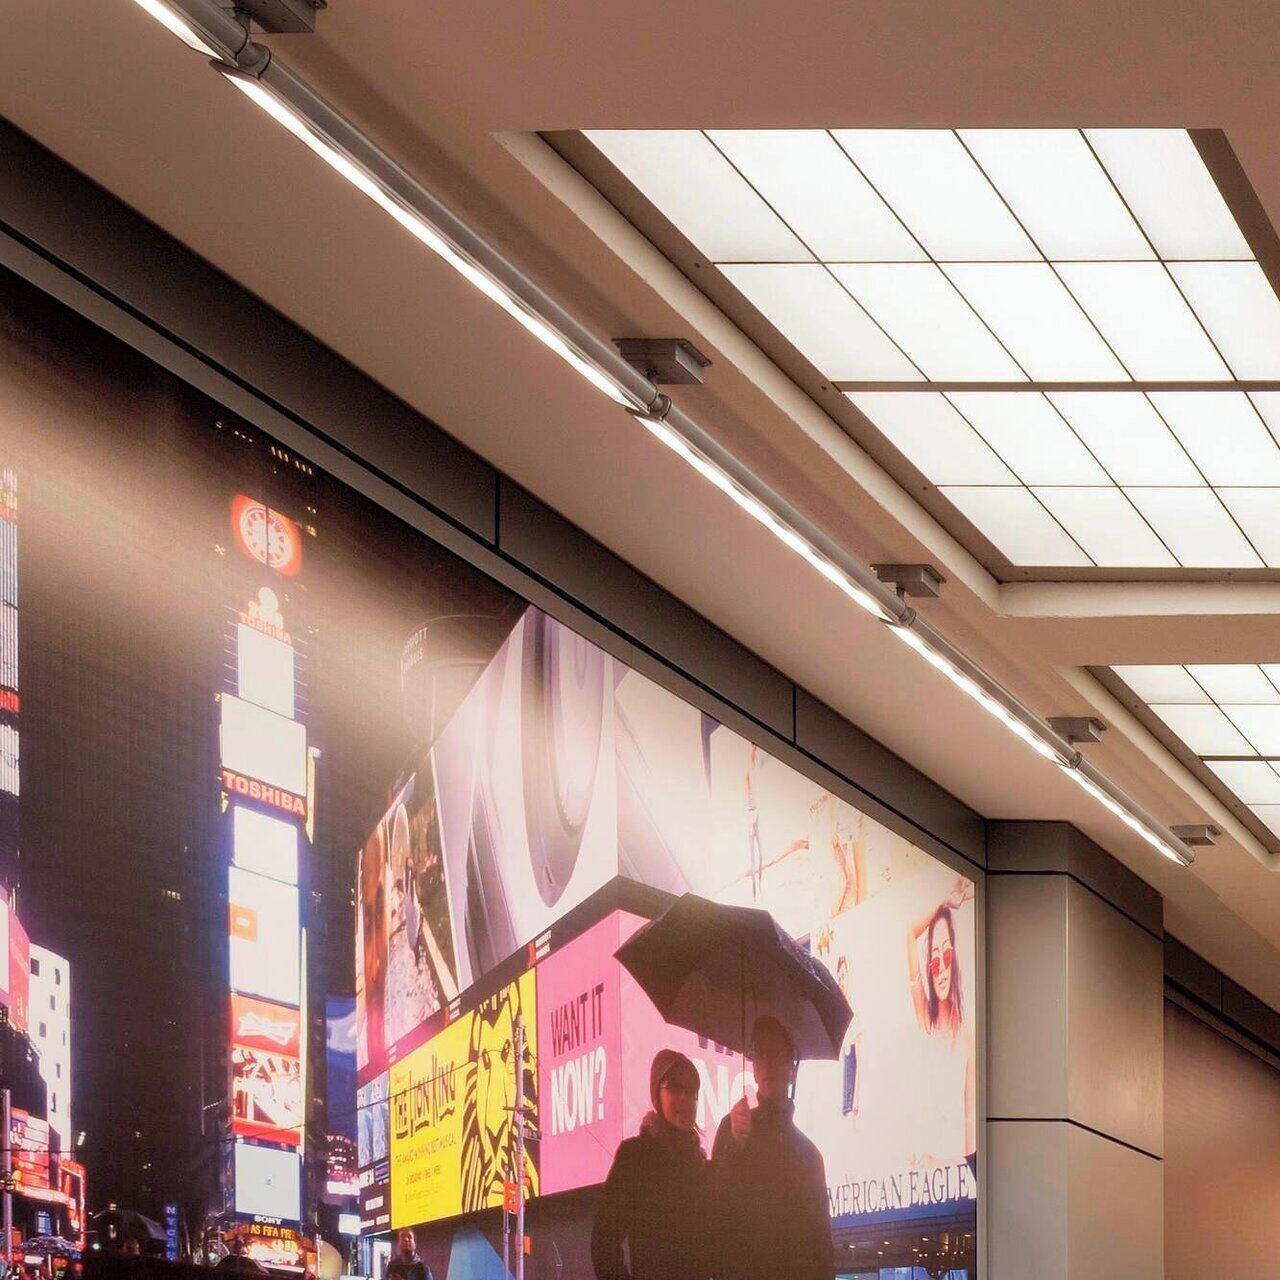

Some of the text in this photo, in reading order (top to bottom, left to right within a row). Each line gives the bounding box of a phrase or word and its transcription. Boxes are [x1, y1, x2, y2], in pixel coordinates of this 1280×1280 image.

[239, 611, 292, 645] TOSHIBA
[223, 770, 306, 816] TOSHIBA
[551, 983, 604, 1058] WANT IT
[395, 1054, 456, 1140] THE LION KING
[551, 1046, 607, 1136] NOW?
[827, 1163, 970, 1218] MERICAN EAGLE
[254, 1215, 282, 1224] SONY
[263, 1226, 279, 1237] FIFA
